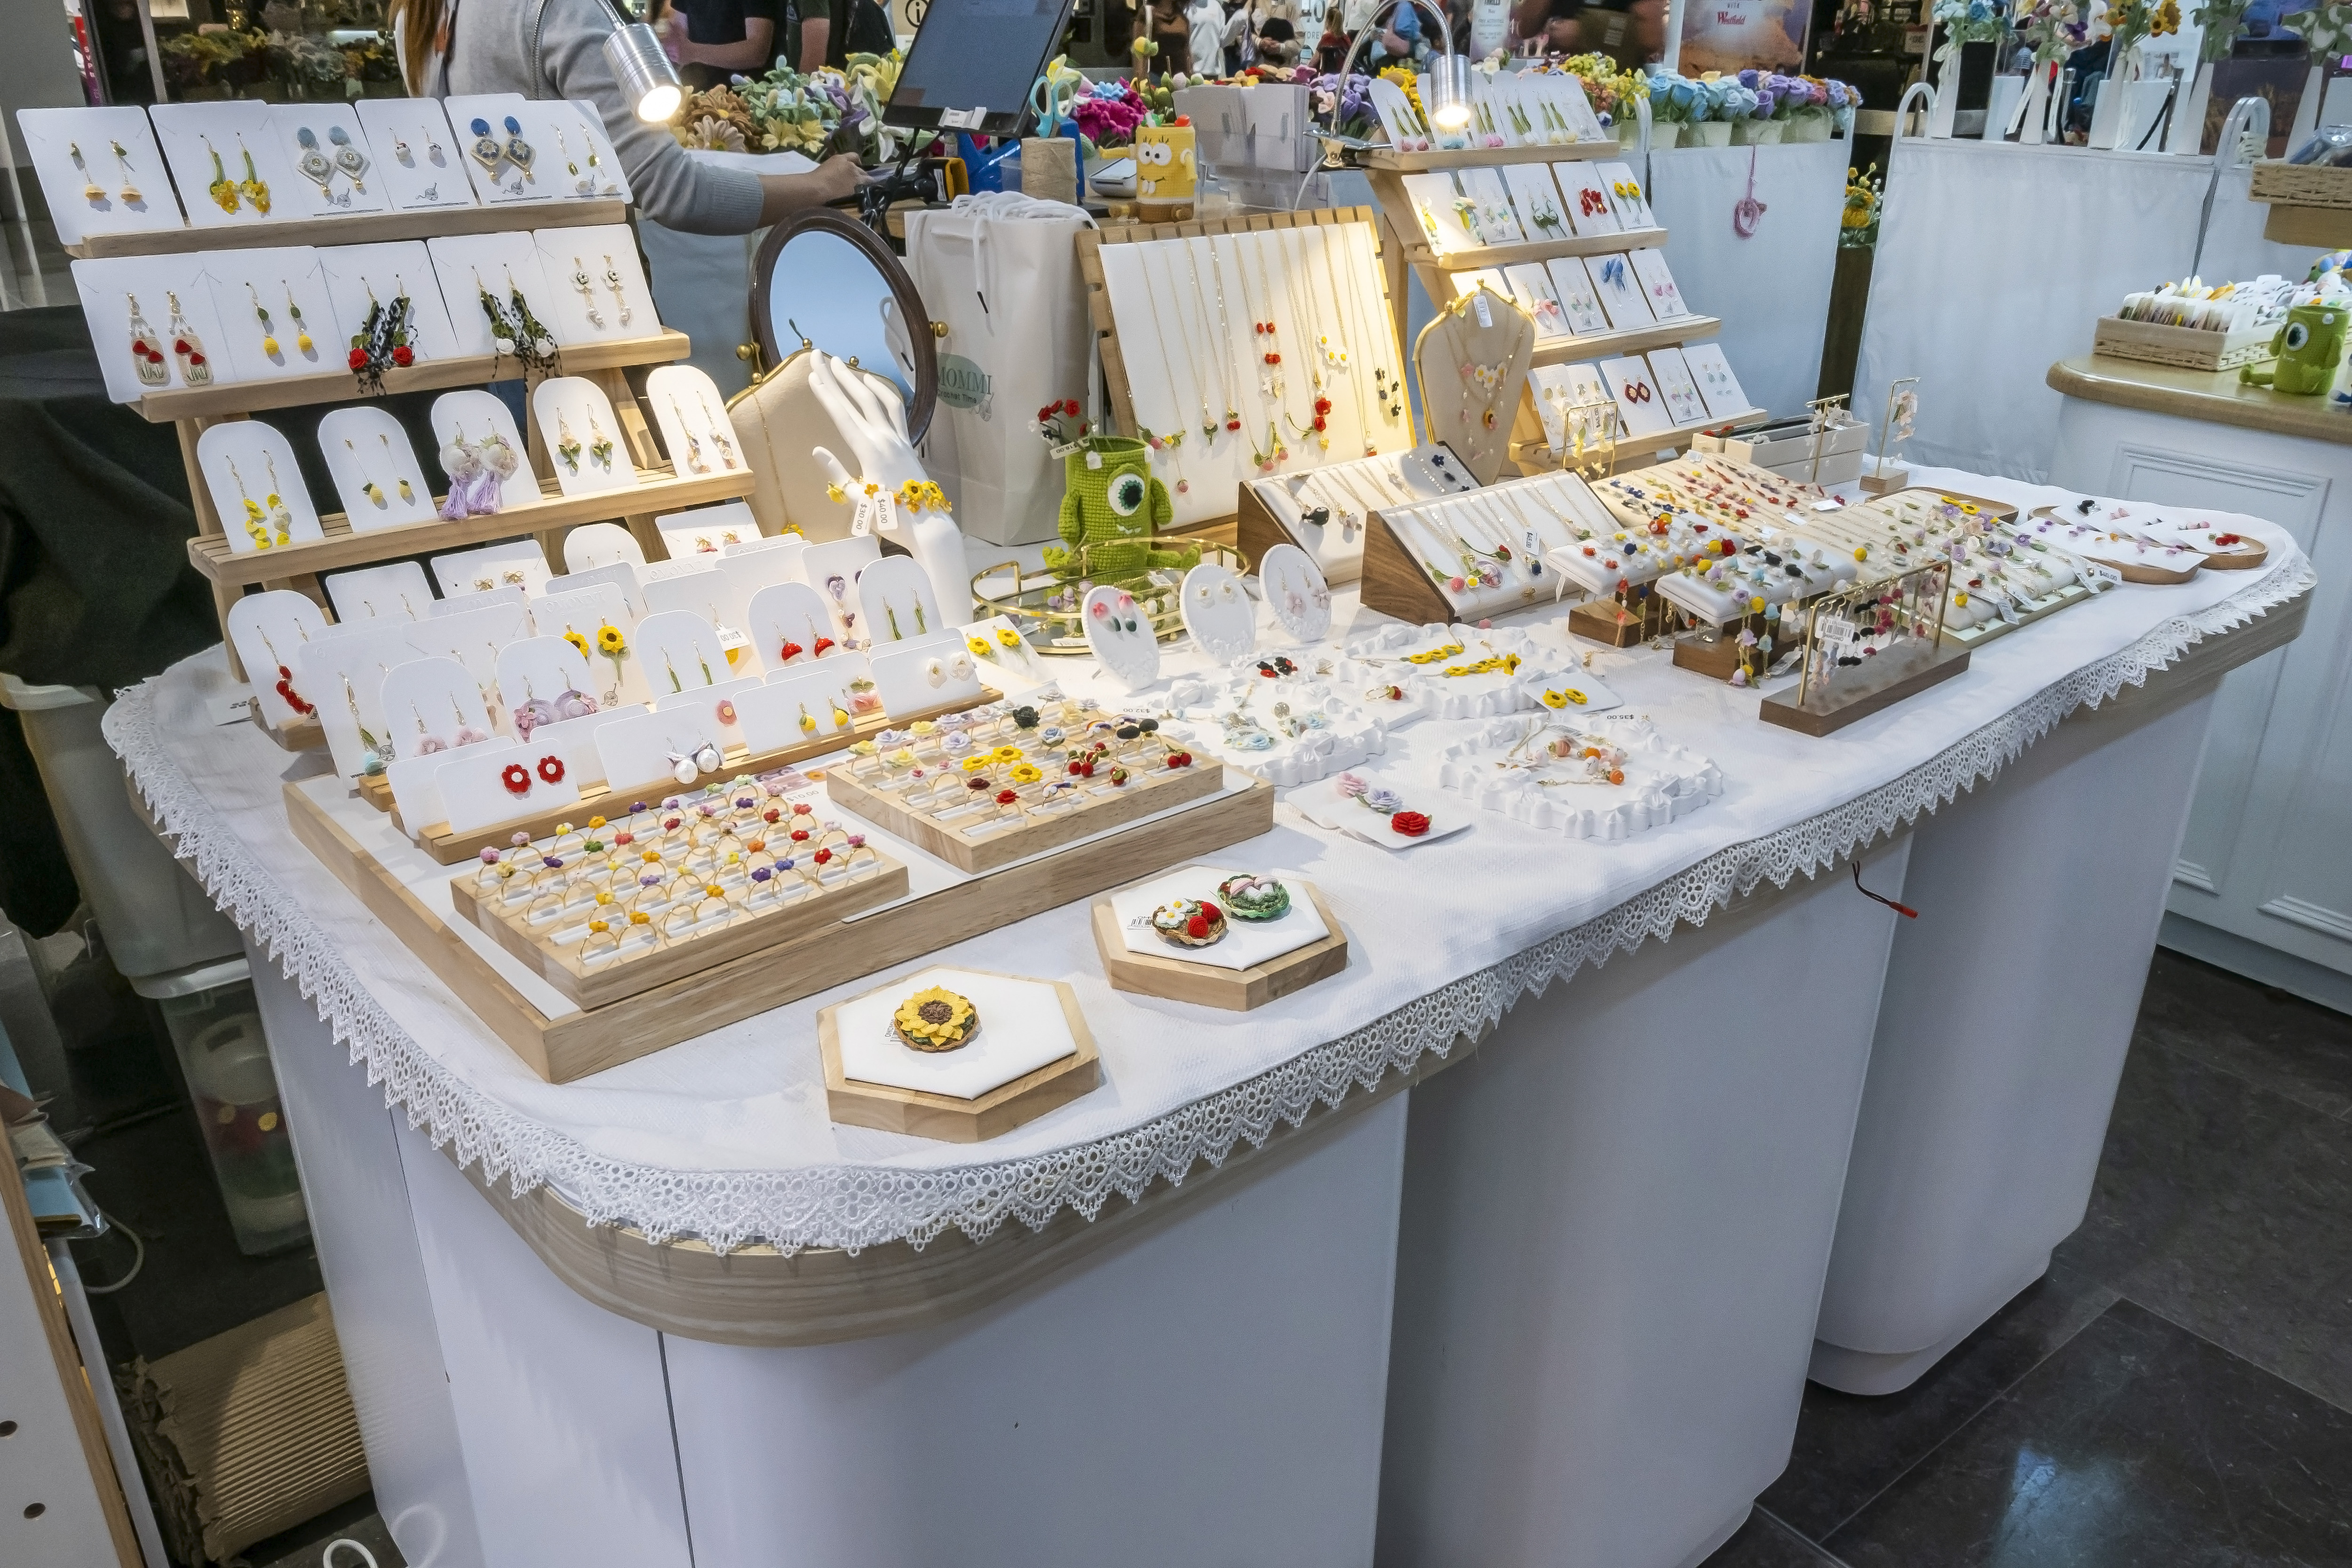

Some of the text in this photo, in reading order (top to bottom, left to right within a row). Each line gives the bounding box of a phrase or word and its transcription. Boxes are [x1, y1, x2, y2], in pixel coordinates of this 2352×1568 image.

[1717, 11, 1747, 25] Westfield
[961, 393, 977, 404] Time
[856, 503, 868, 530] $30.00
[877, 498, 888, 524] $40.00
[786, 790, 819, 802] $10.00
